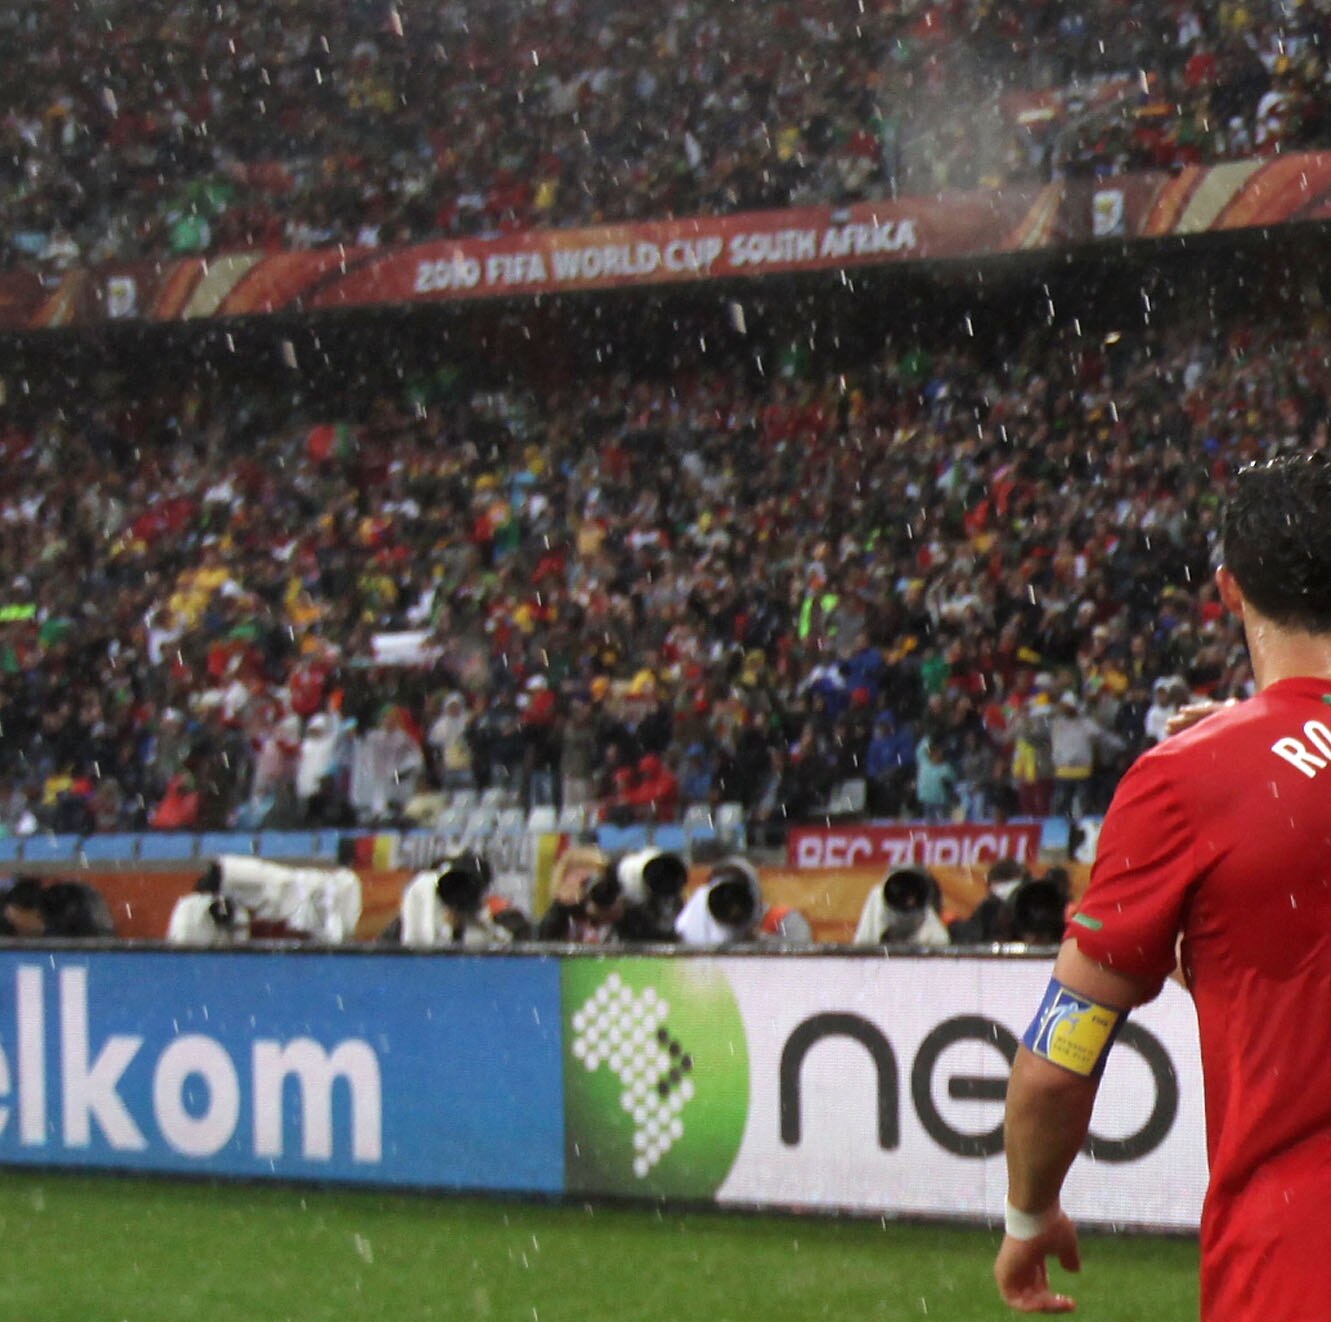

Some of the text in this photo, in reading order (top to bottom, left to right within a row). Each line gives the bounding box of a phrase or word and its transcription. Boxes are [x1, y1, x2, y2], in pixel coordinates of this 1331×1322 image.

[486, 252, 547, 285] FIFA
[550, 241, 664, 281] WORLD
[662, 235, 724, 273] CUP
[729, 226, 816, 266] SOUTH
[821, 218, 918, 258] AFRICA
[0, 965, 383, 1163] lkom
[778, 1010, 1180, 1163] neo
